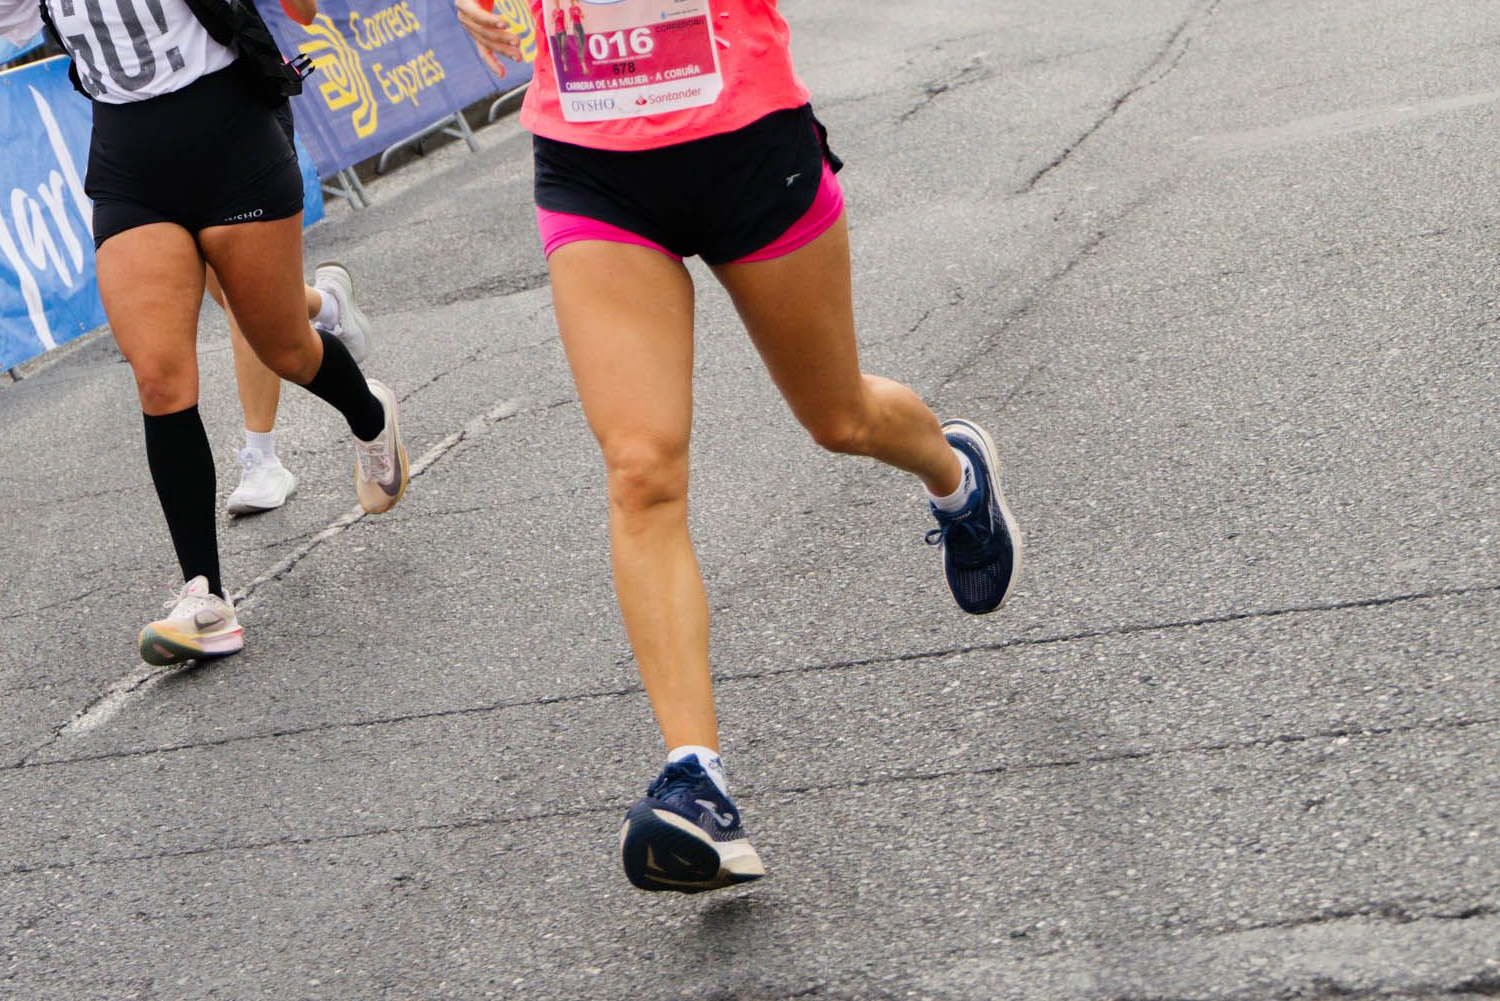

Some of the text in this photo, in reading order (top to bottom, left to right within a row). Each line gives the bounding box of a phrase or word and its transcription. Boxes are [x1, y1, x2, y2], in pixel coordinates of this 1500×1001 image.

[350, 1, 420, 51] Correos
[588, 27, 654, 61] 016
[372, 49, 446, 108] Express
[612, 61, 636, 76] 678
[572, 98, 616, 112] OYSHO
[648, 87, 702, 105] Santander
